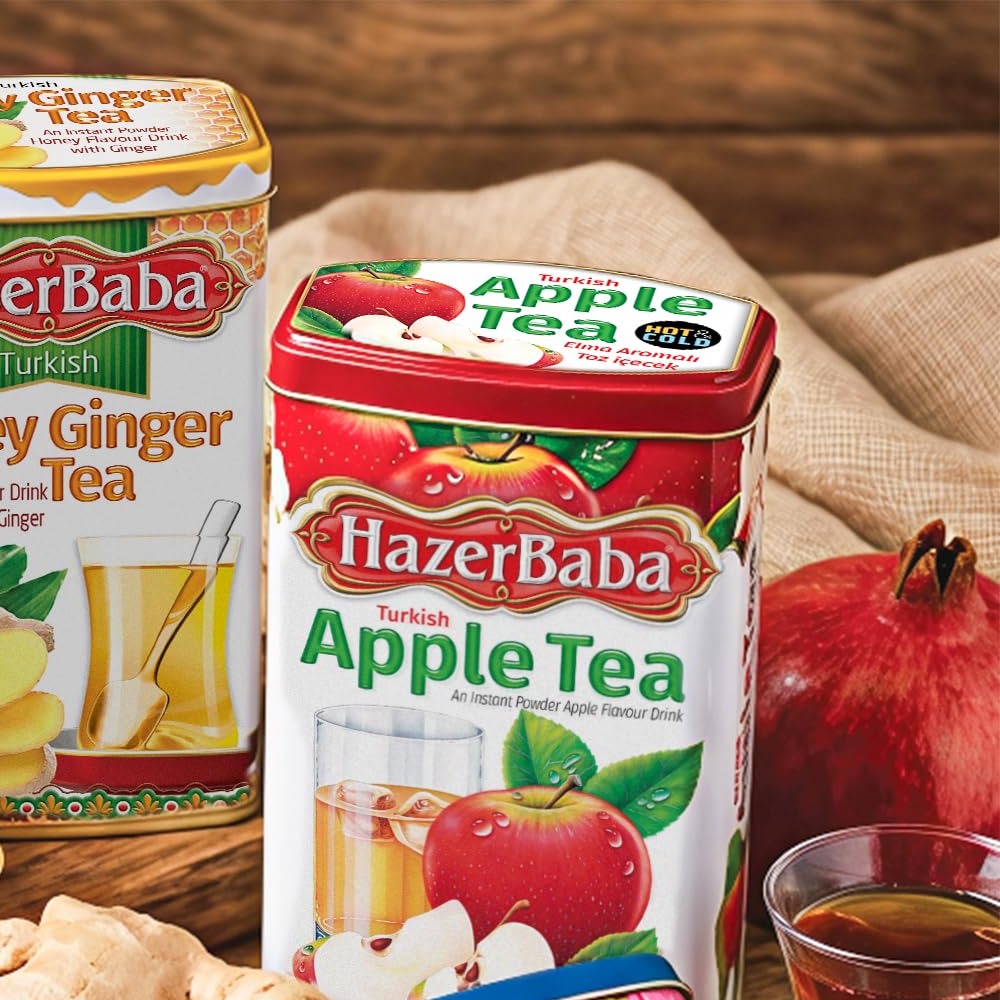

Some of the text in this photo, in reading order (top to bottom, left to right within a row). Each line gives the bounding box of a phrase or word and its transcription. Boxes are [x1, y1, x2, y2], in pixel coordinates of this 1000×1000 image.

[28, 85, 196, 109] Ginger
[35, 108, 134, 125] Tea
[30, 133, 189, 146] Honey Flavour Drink
[43, 125, 171, 135] An Instant Powder
[70, 143, 159, 155] with Ginger
[537, 273, 620, 287] Turkish
[470, 276, 714, 317] Apple
[472, 303, 619, 344] Tea
[564, 340, 700, 363] Elma Aromalı
[642, 333, 711, 347] COLD
[577, 352, 610, 364] Toz
[49, 398, 232, 462] Ginger
[40, 456, 136, 502] Tea
[10, 483, 49, 501] Drink
[339, 514, 673, 593] HazerBaba
[376, 604, 450, 628] Turkish
[300, 607, 686, 703] Apple Tea
[451, 689, 683, 723] An Instant Powder Apple Flavour Drink
